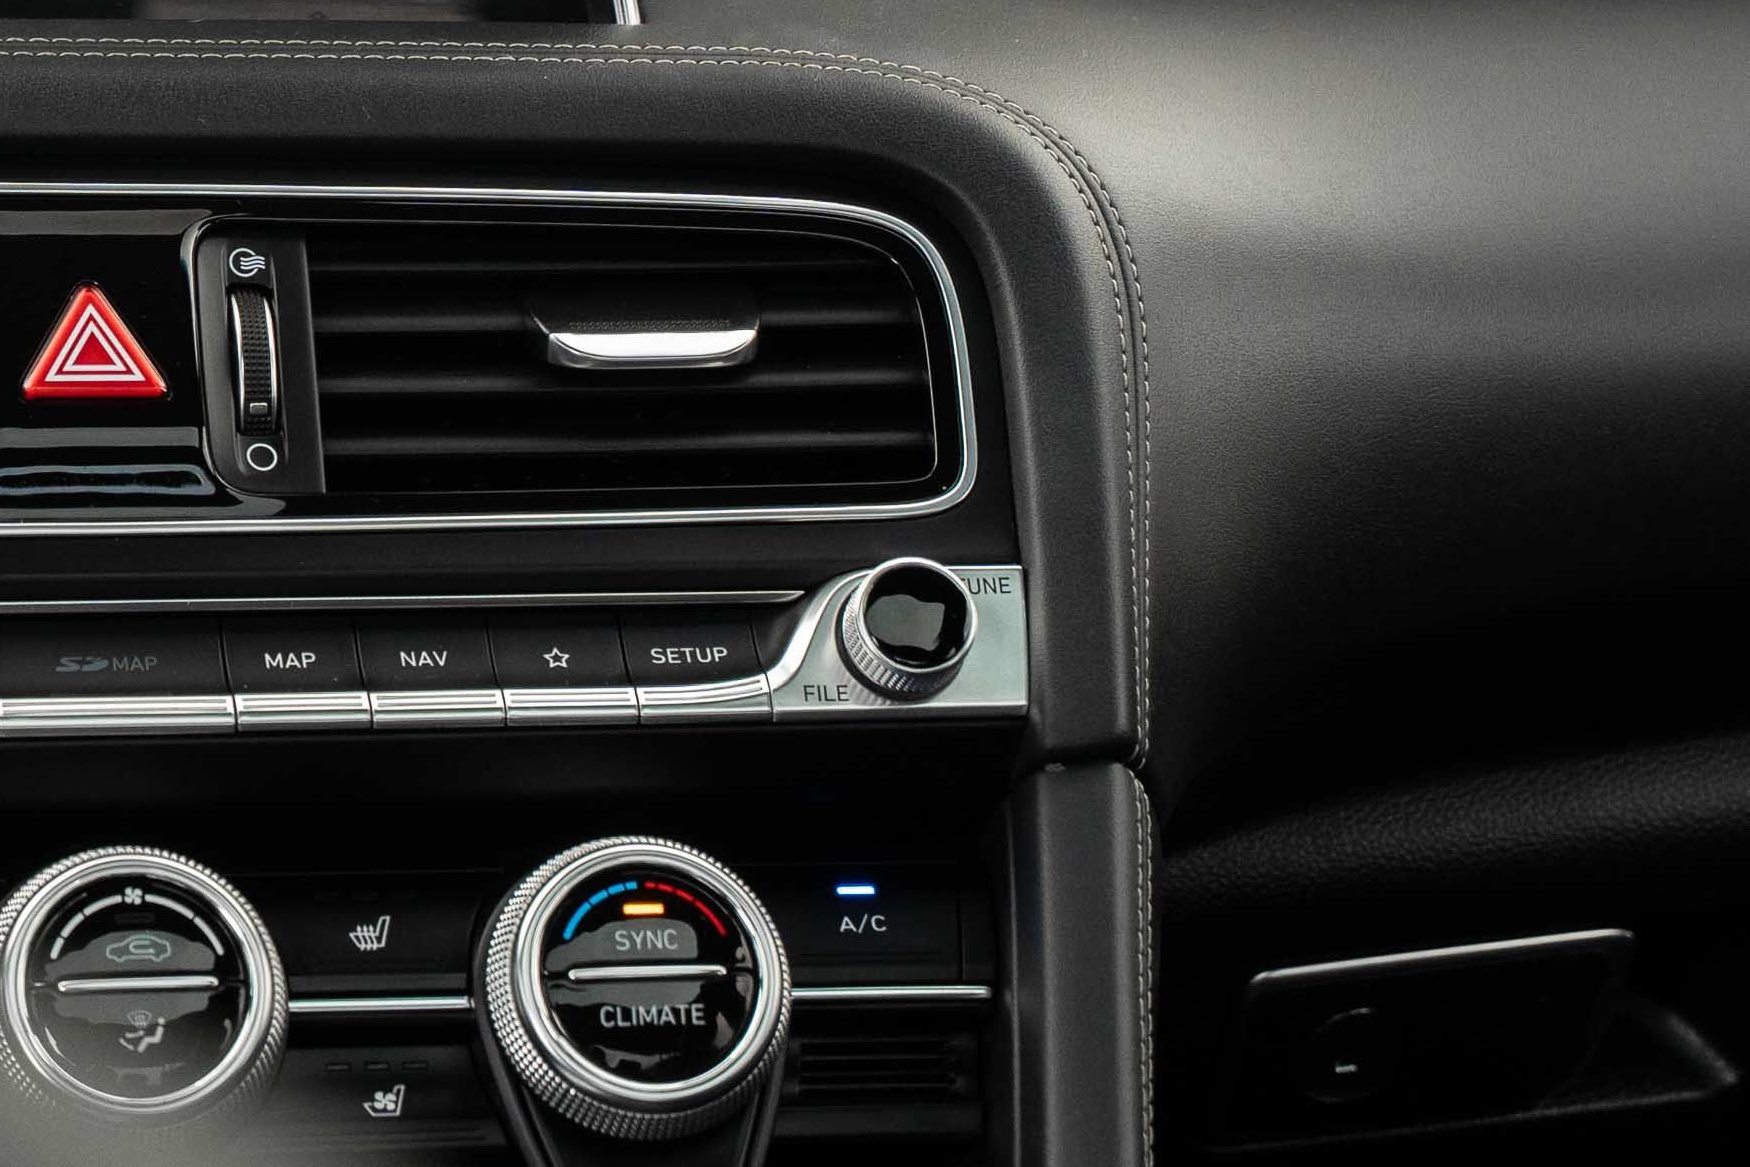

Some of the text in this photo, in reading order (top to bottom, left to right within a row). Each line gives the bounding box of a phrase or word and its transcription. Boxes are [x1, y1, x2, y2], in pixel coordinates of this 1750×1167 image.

[961, 577, 1012, 595] UNE
[112, 656, 158, 672] MAP
[264, 651, 316, 670] MAP
[399, 650, 448, 668] NAV
[650, 647, 729, 666] SETUP
[803, 683, 848, 703] FILE
[840, 914, 887, 934] A/C
[615, 929, 678, 952] SYNC
[600, 1004, 706, 1029] CLIMATE
